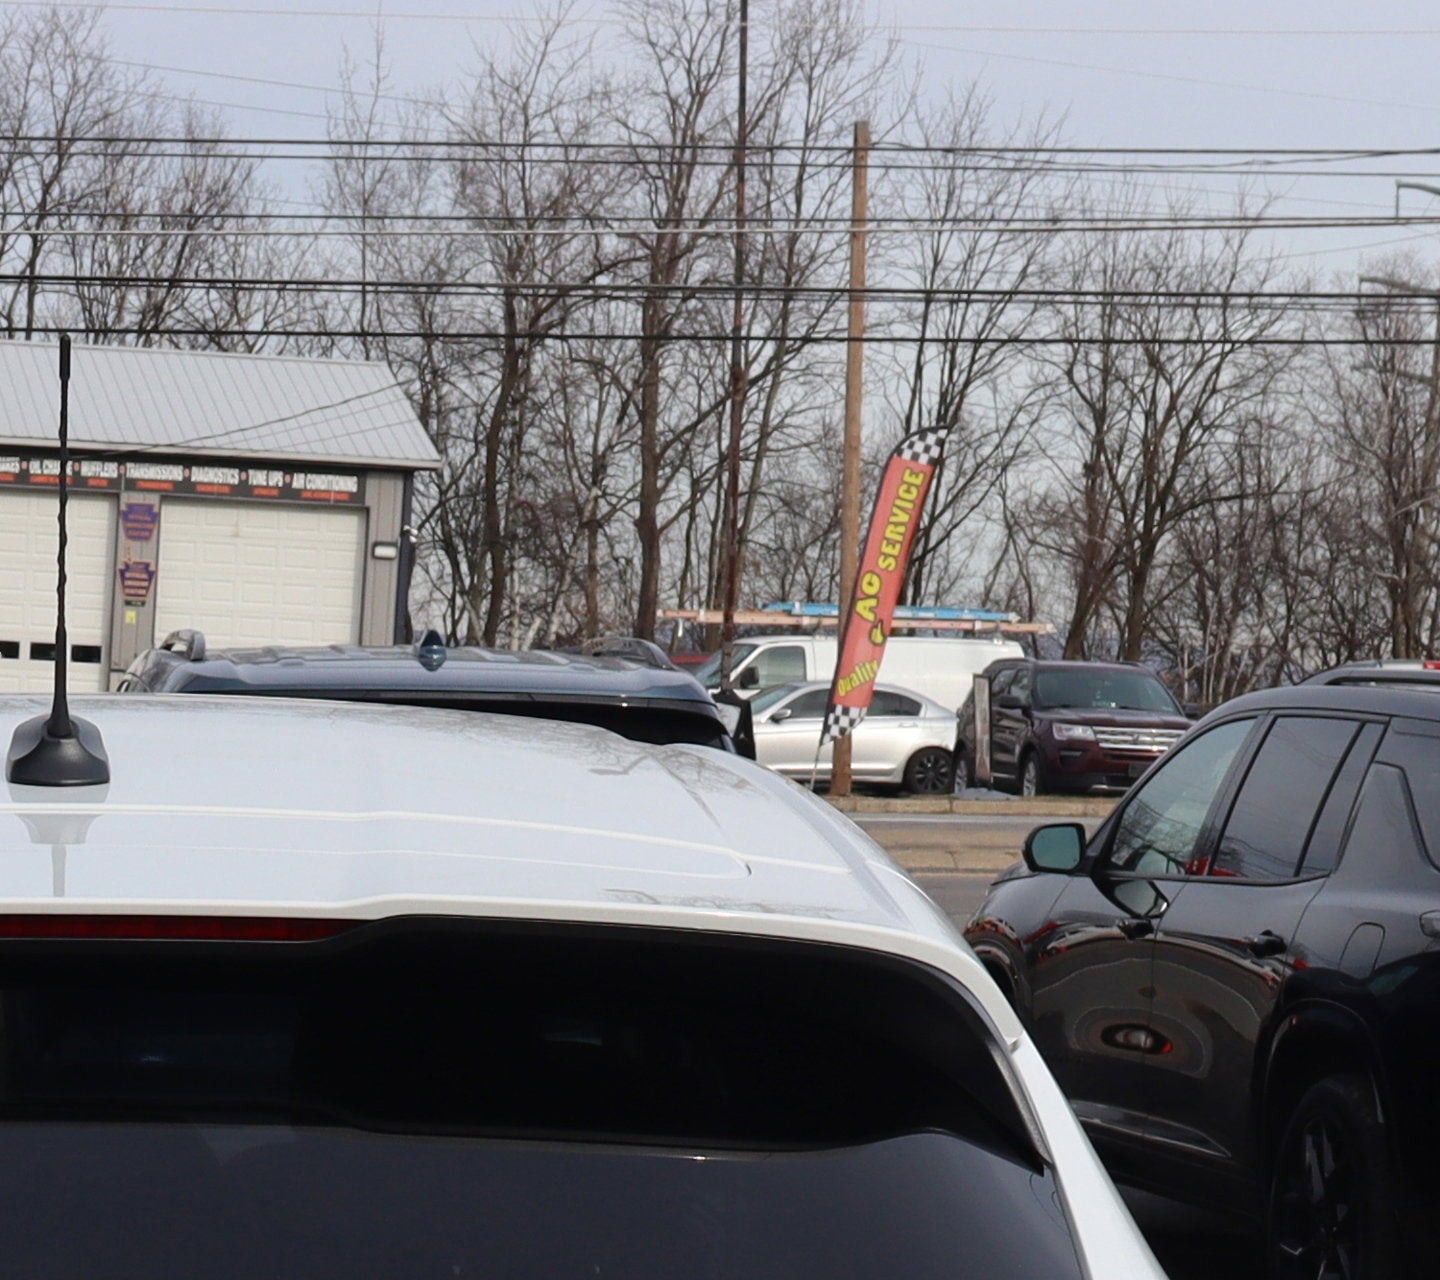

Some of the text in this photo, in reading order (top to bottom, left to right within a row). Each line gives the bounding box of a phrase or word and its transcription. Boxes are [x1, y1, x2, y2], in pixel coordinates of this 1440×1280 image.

[126, 463, 358, 492] TRANSMISSIONS DIAGNOSTICS TUNE UPS AIR CONDITIONING
[855, 468, 926, 622] AC SERVICE
